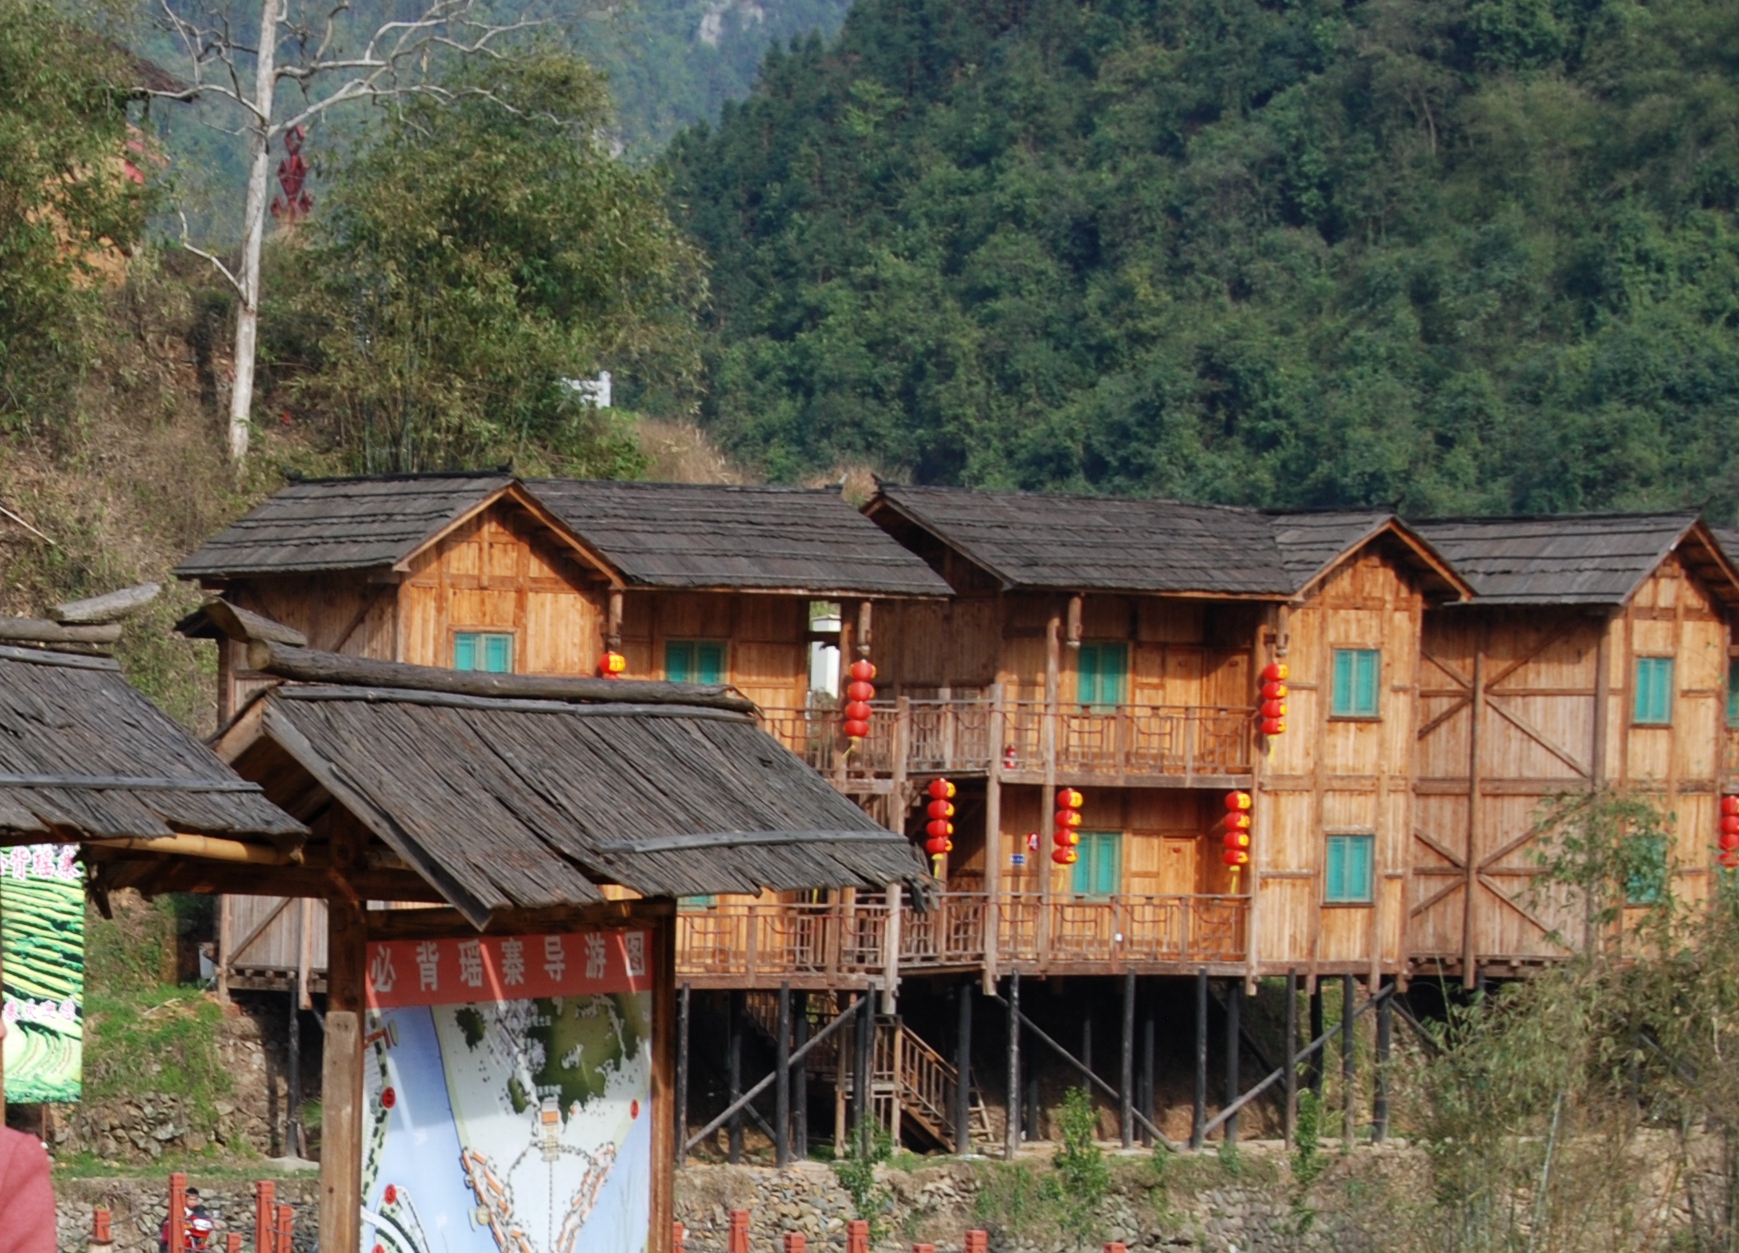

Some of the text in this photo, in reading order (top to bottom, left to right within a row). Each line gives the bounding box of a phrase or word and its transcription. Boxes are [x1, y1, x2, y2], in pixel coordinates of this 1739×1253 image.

[370, 930, 646, 993] 必背瑶寨导游图
